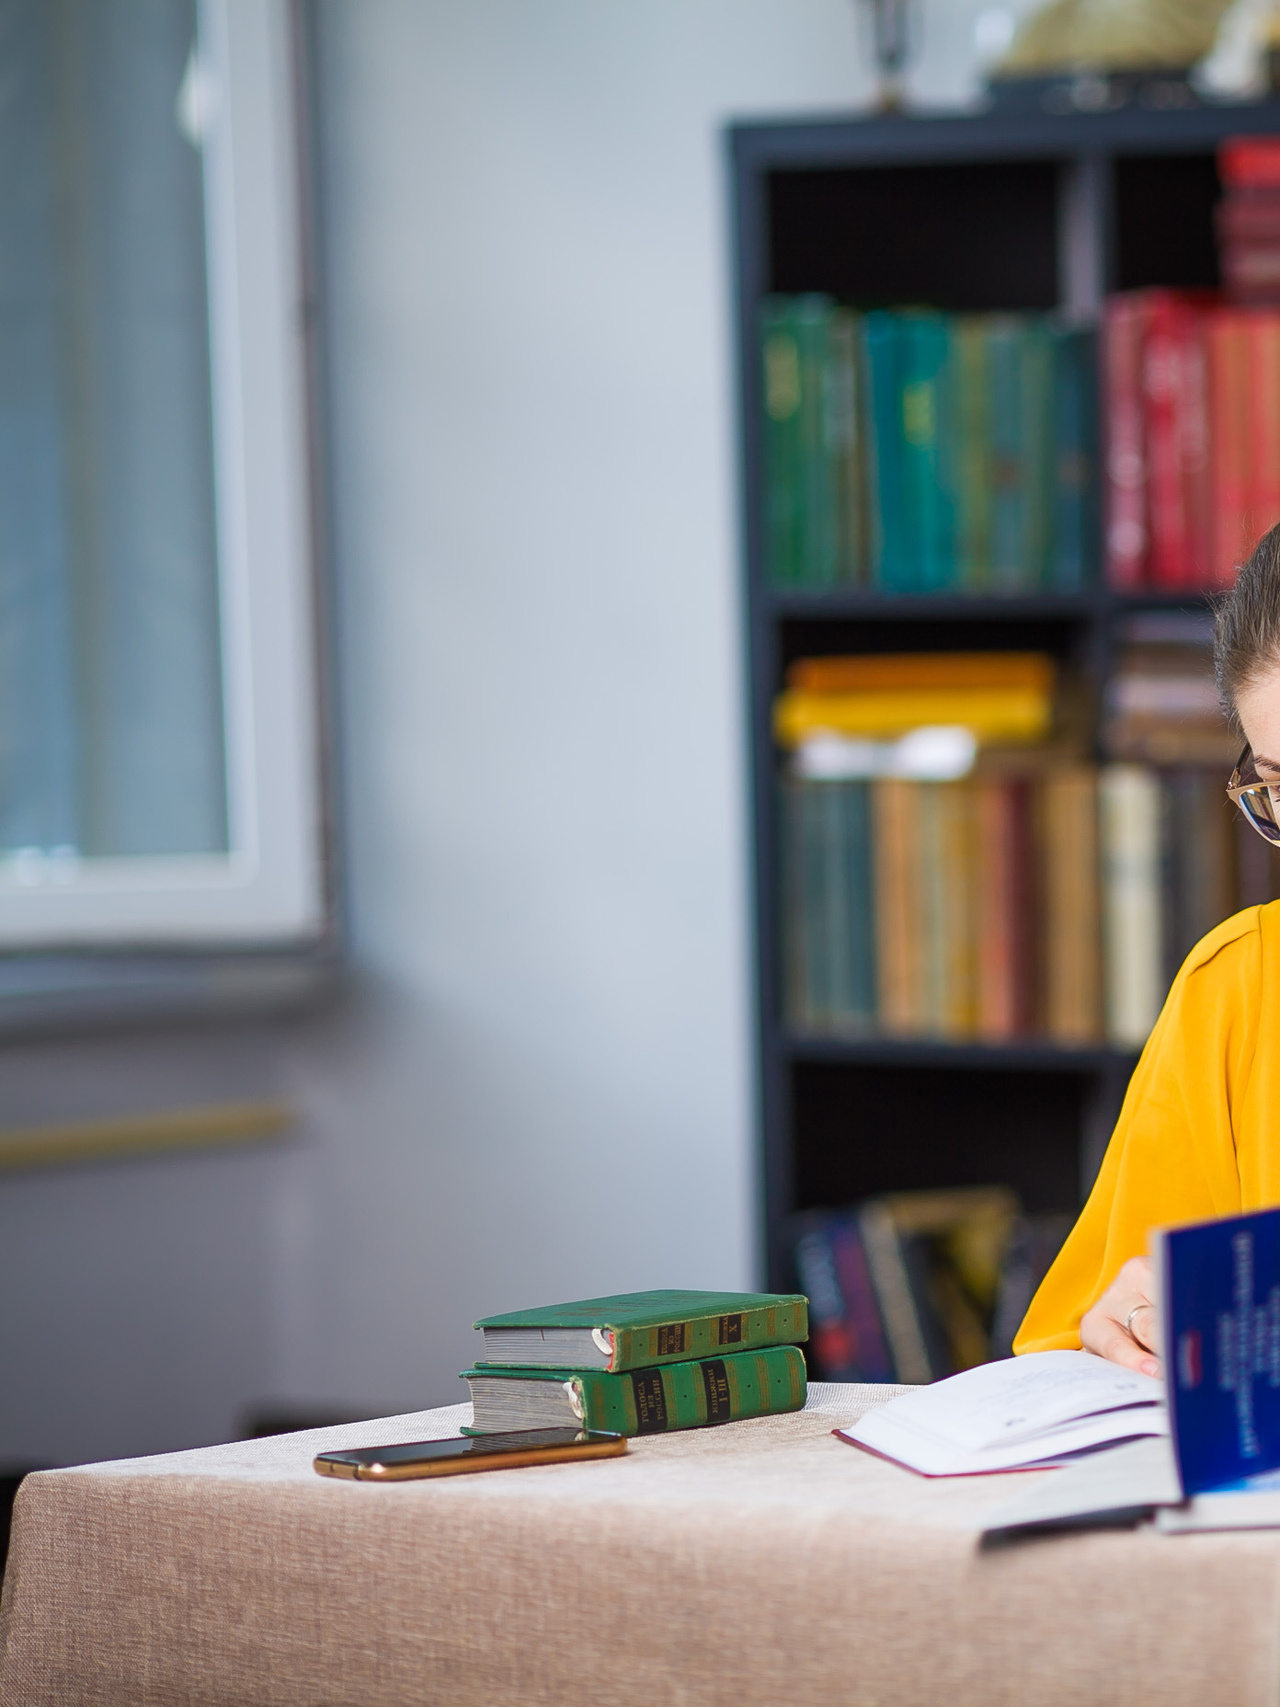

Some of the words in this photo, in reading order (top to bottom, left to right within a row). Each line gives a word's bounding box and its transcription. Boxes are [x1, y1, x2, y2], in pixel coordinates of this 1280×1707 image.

[638, 1381, 649, 1423] ГОЛОСА
[647, 1395, 655, 1408] ИЗ
[652, 1379, 664, 1420] РОССИИ
[708, 1368, 718, 1413] КНИЖКИ
